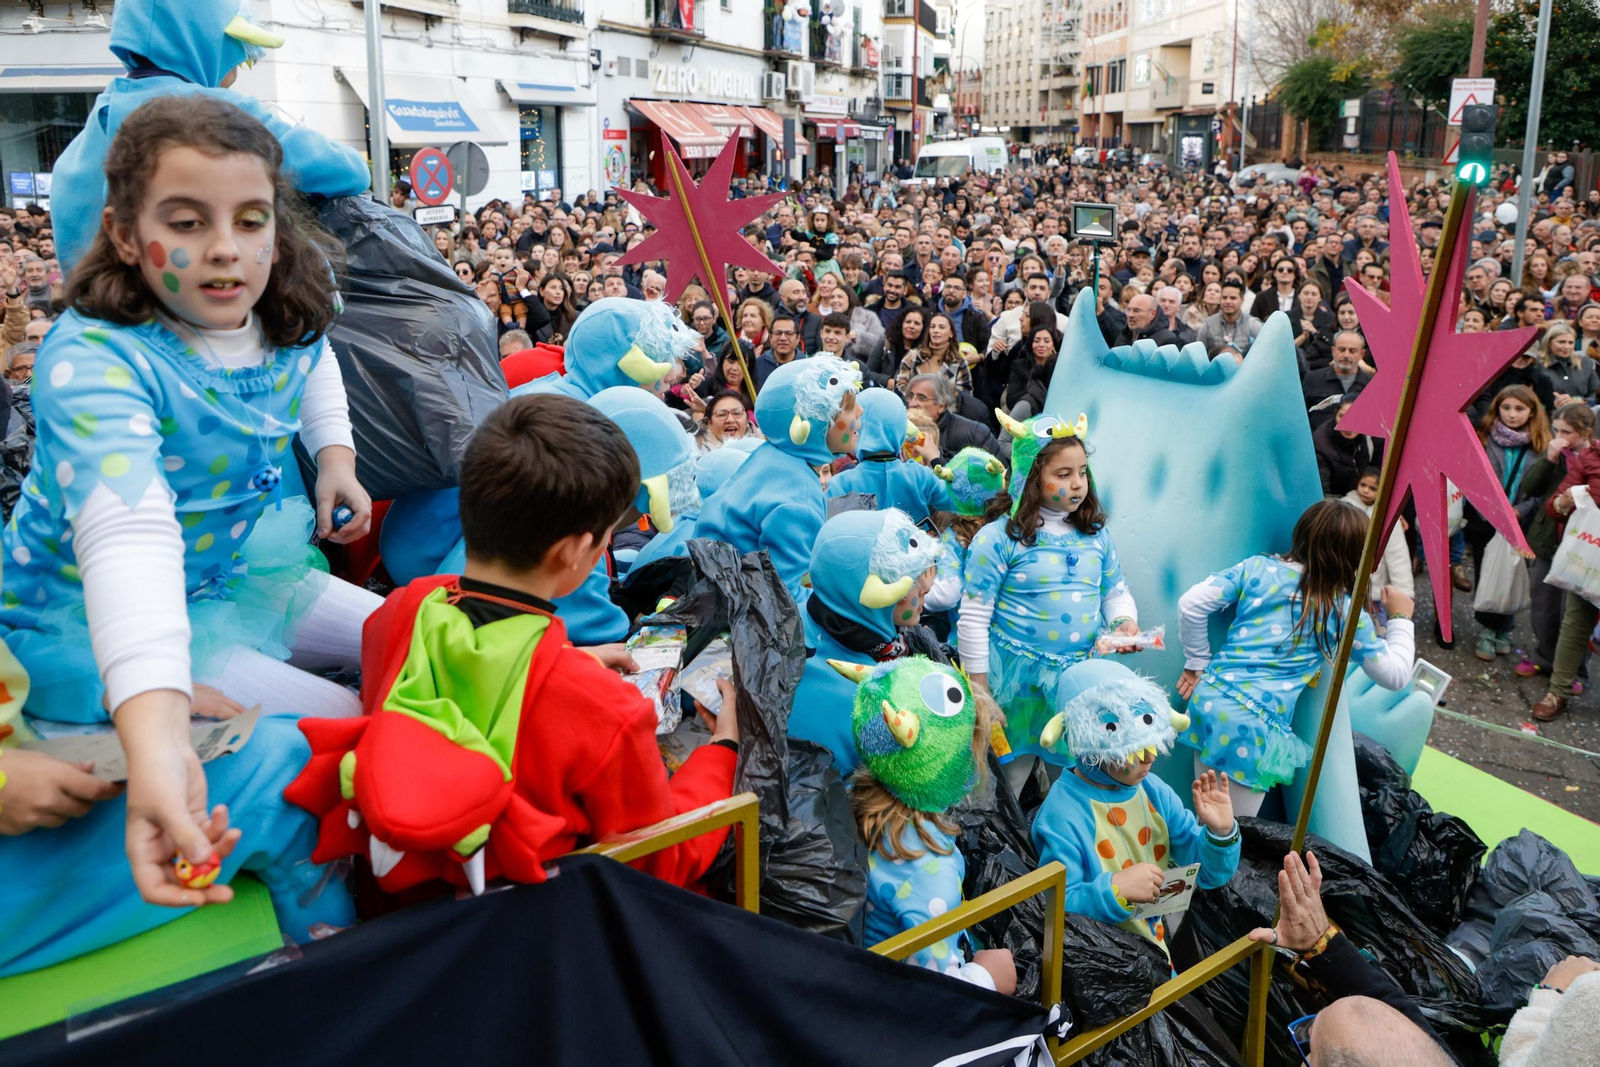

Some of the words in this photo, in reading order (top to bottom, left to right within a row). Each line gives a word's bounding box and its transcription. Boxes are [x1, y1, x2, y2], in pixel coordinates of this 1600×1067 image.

[653, 63, 699, 95] ZERO
[707, 68, 757, 99] DIGITAL
[388, 105, 460, 119] Guadalquivir
[1212, 120, 1220, 131] P
